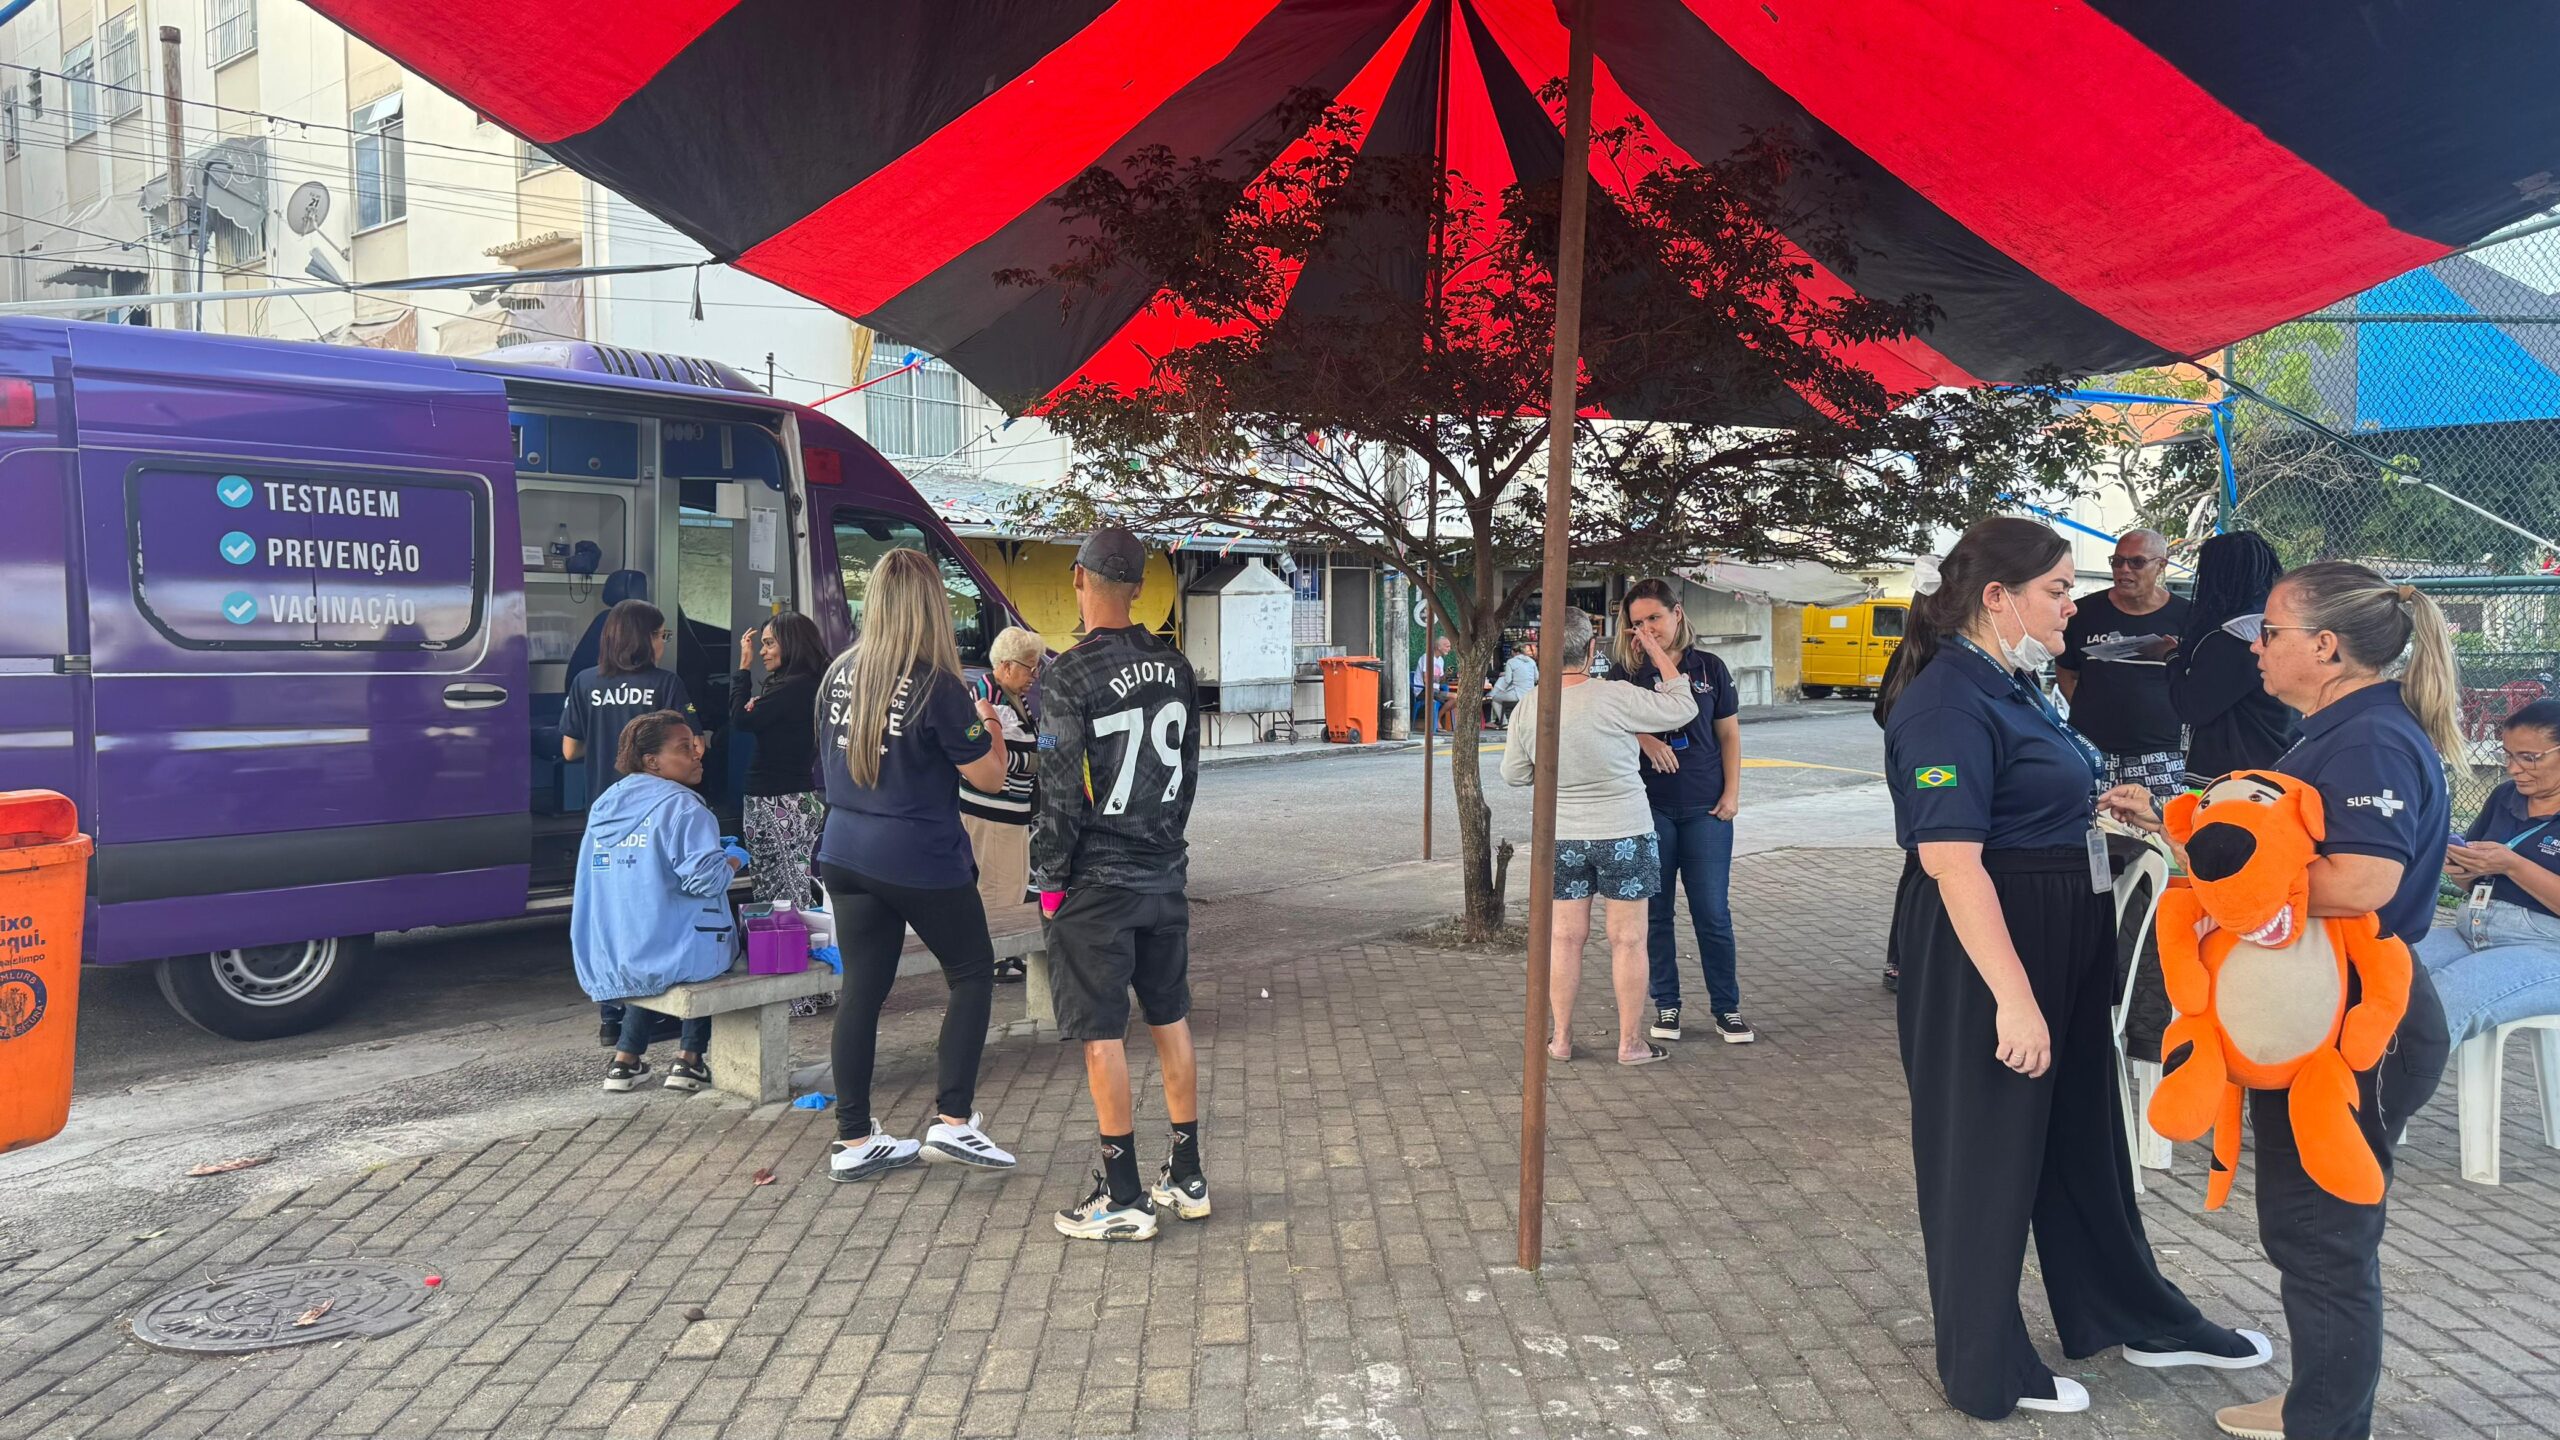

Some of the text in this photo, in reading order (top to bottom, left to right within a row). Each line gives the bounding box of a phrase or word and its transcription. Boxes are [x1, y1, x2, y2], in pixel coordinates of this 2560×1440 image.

[263, 481, 400, 518] TESTAGEM
[267, 537, 420, 576] PREVENÇÃO
[269, 593, 416, 630] VACINAÇÃO
[591, 682, 655, 707] SAÚDE
[1108, 661, 1176, 699] DEJOTA
[1092, 701, 1188, 816] 79
[2141, 751, 2169, 765] DIESEL
[2145, 773, 2174, 786] DIESEL
[2346, 796, 2371, 807] SUS
[0, 915, 33, 932] ixo
